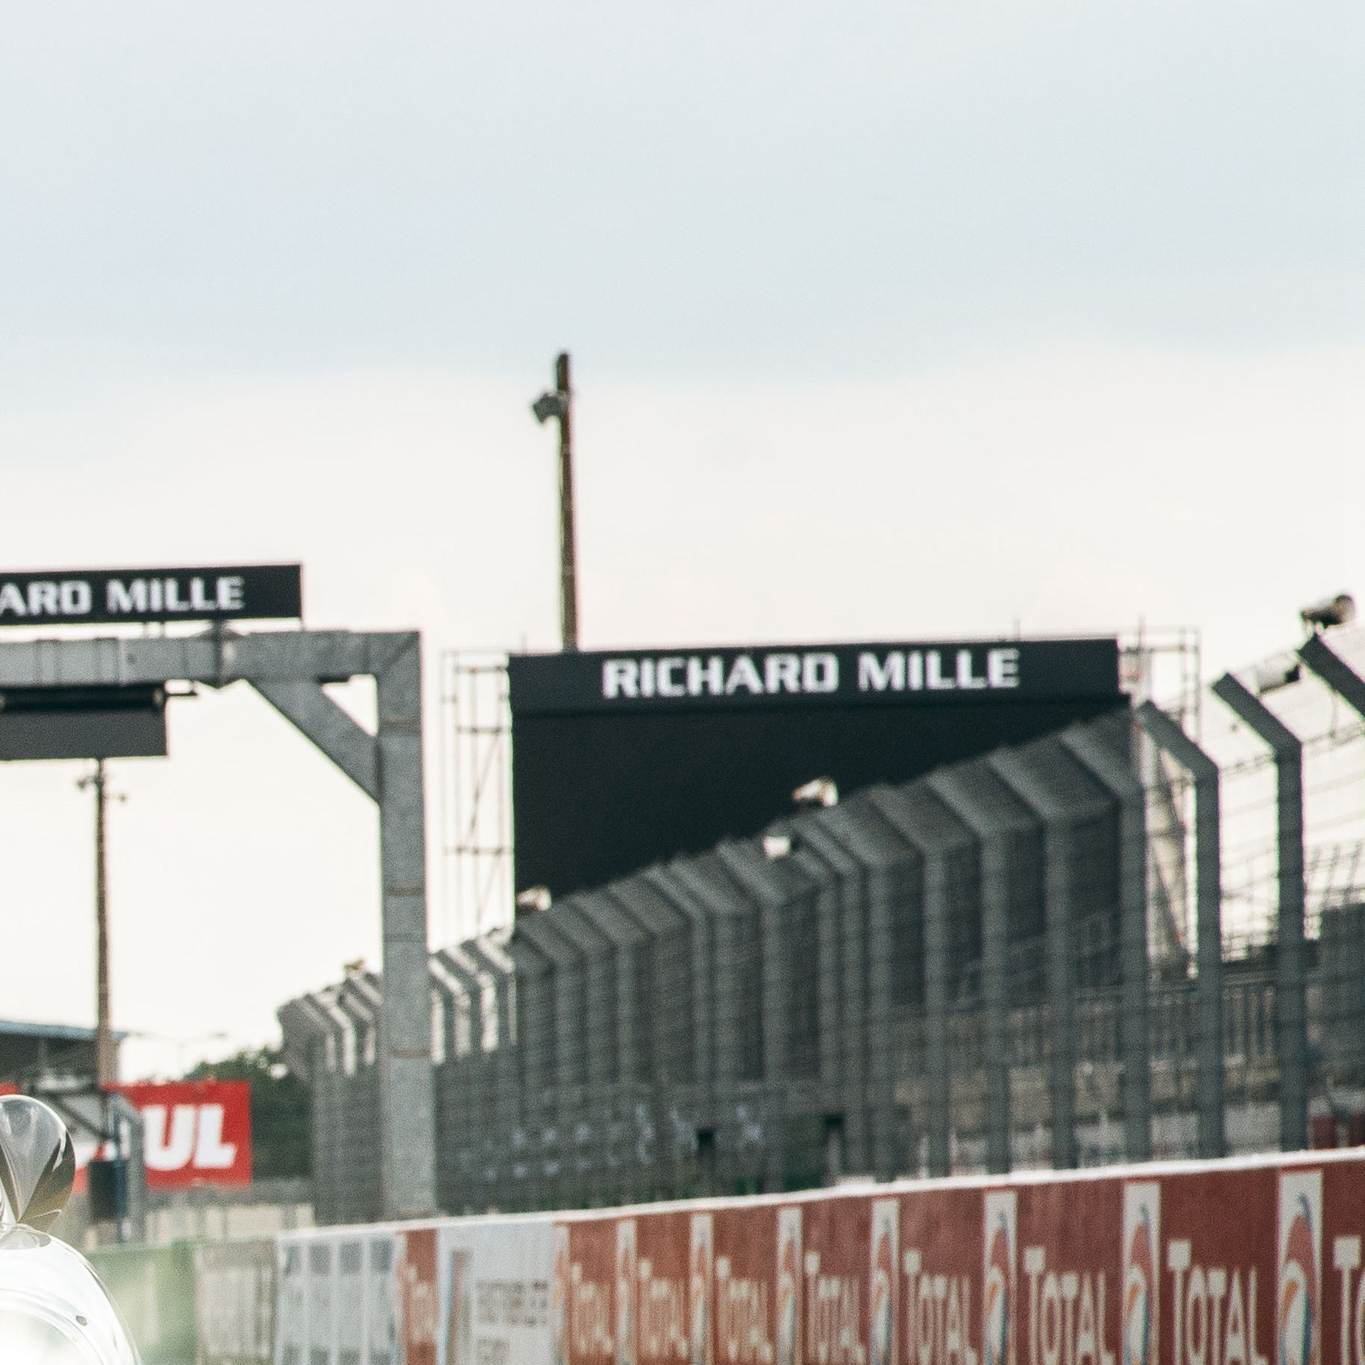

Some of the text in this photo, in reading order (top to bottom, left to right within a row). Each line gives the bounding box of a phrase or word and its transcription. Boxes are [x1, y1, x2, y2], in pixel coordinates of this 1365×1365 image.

[106, 575, 245, 615] MILLE
[602, 647, 1021, 700] RICHARD MILLE
[717, 1256, 772, 1364] TOTAL
